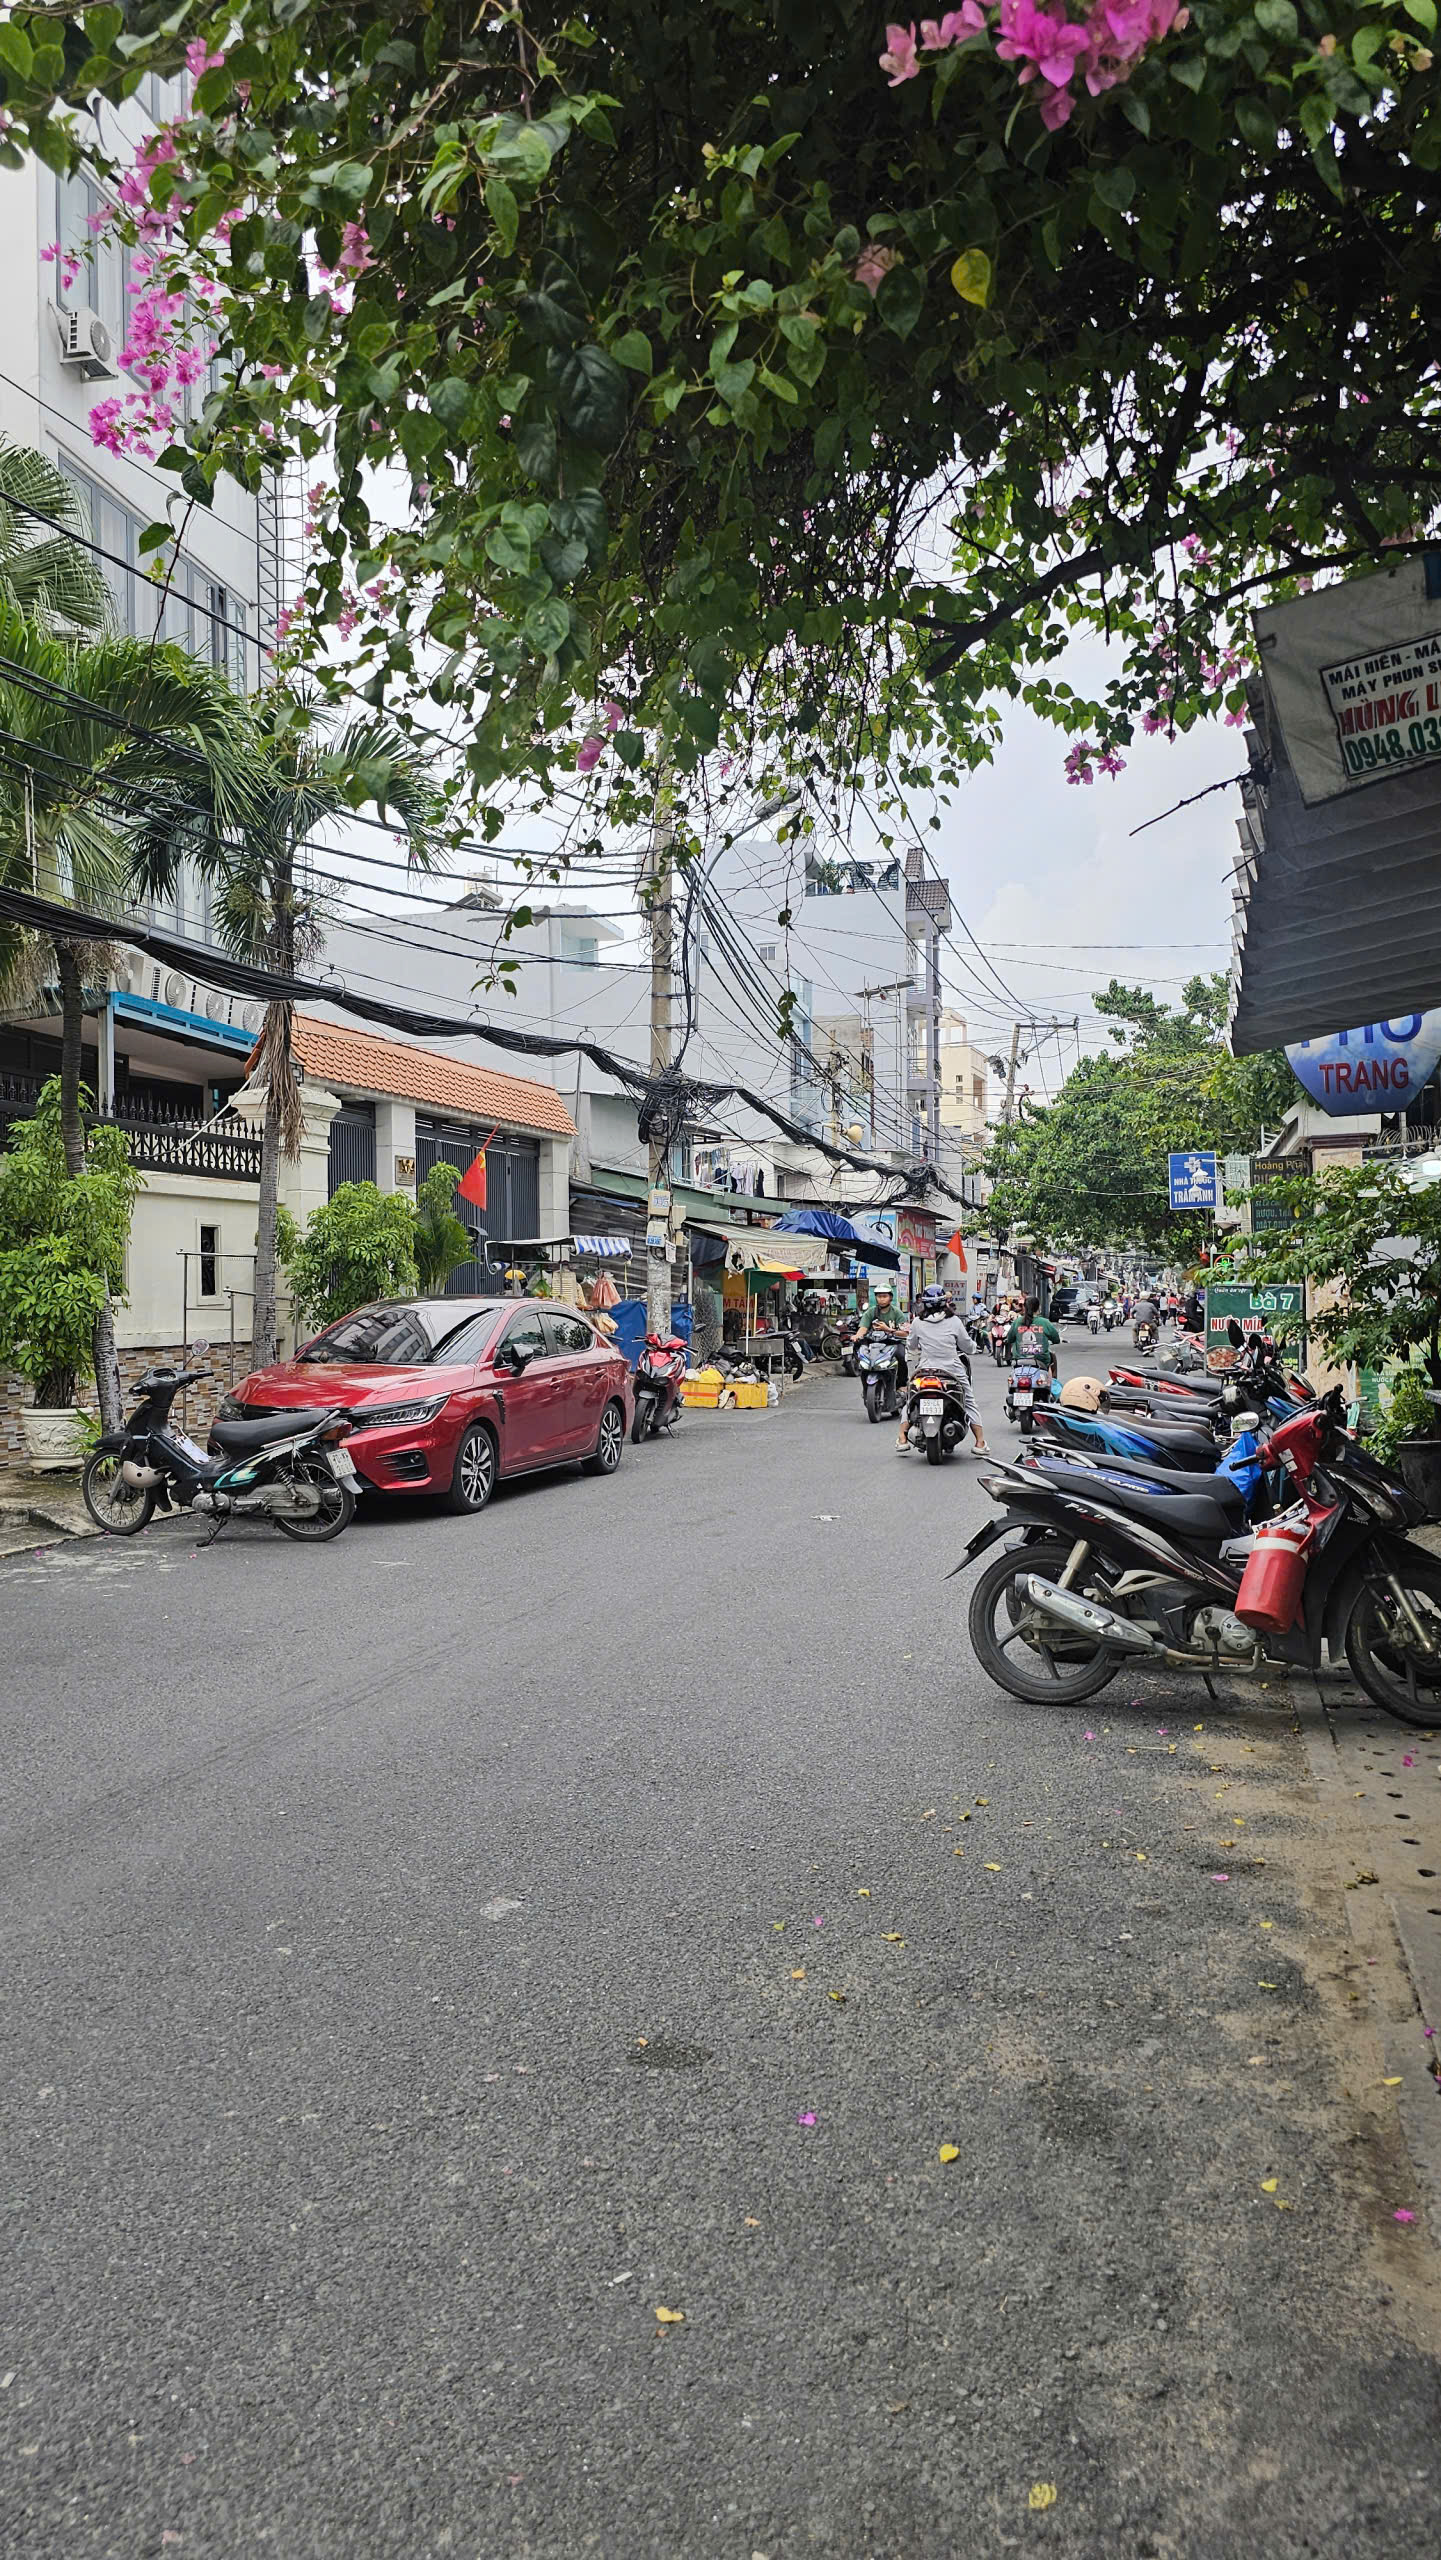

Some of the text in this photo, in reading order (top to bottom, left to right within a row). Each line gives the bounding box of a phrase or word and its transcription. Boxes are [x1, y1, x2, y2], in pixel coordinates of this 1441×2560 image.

[1328, 666, 1360, 685] MÁI
[1364, 652, 1402, 675] HIÊN
[1341, 678, 1377, 700] MÁY
[1382, 664, 1425, 688] PHUN
[1426, 681, 1441, 712] L
[1319, 1057, 1409, 1094] TRANG
[1249, 1291, 1294, 1310] Bà 7
[1242, 1315, 1265, 1332] MÍA
[1347, 1516, 1369, 1526] HONDA
